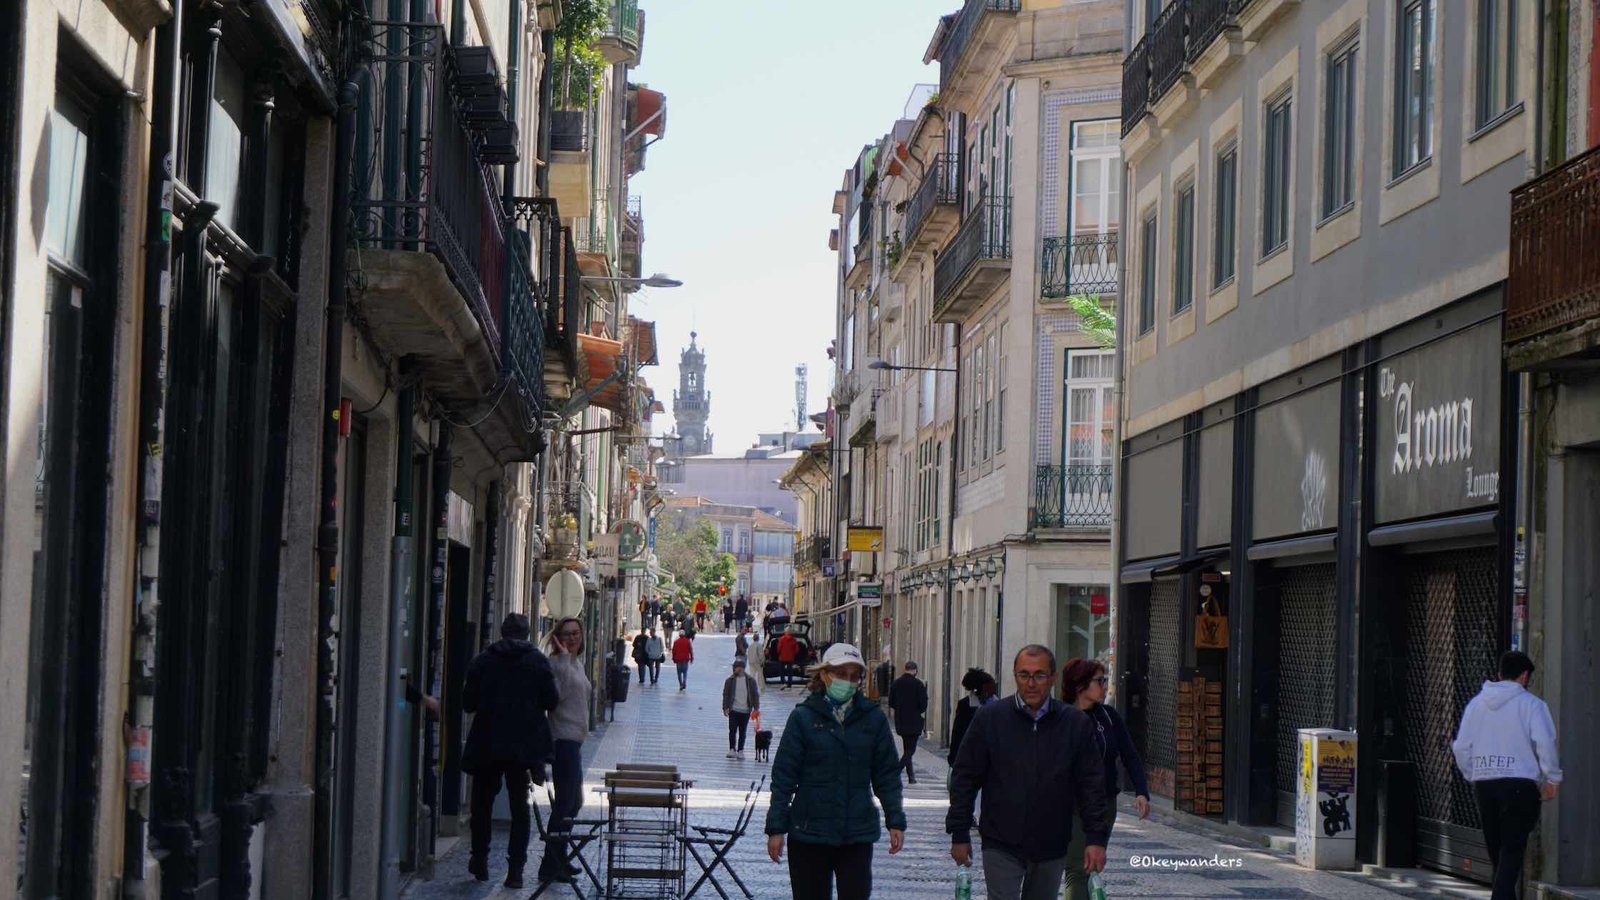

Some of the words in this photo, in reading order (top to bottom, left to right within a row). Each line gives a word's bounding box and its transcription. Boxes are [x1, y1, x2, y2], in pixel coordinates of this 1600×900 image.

[1380, 368, 1396, 401] The
[1393, 381, 1474, 475] Aroma
[1466, 466, 1500, 501] Lounge
[1474, 755, 1516, 769] TAFEP
